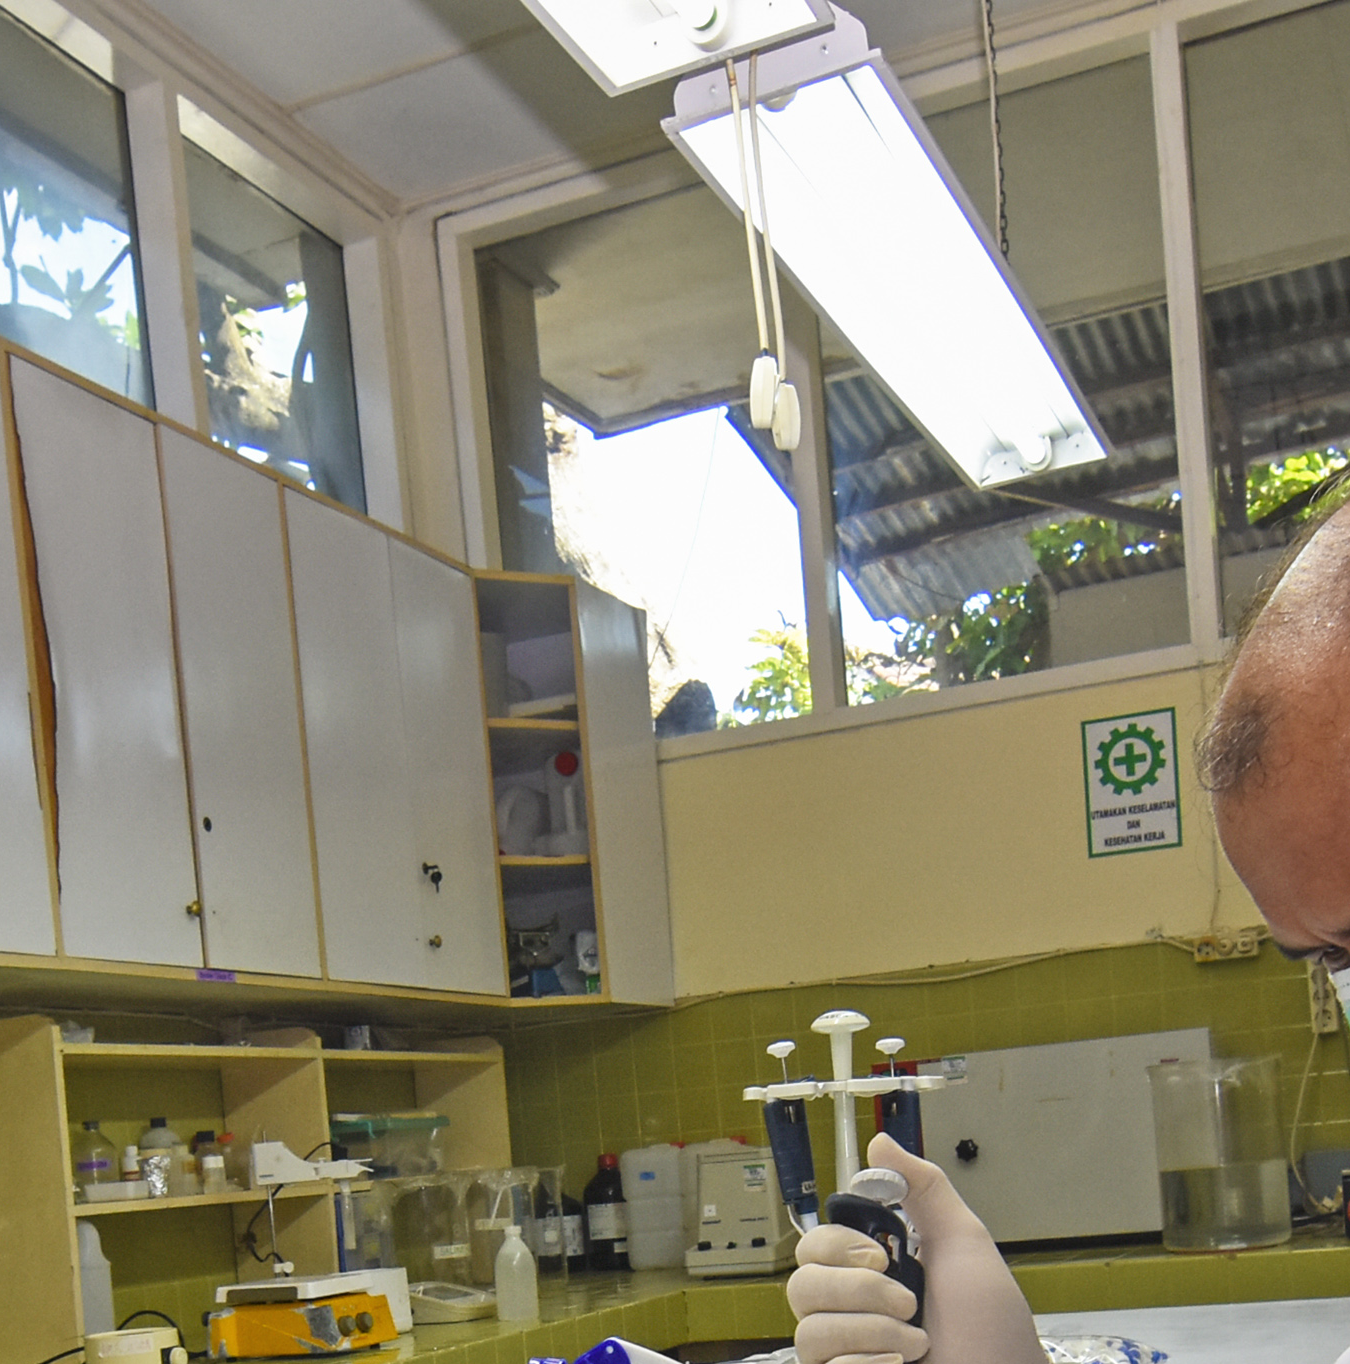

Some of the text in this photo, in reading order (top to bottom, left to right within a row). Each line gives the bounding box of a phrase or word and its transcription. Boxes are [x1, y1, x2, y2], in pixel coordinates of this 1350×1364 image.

[1091, 800, 1176, 821] UTAMAKAN KESELAMATAN
[1126, 819, 1141, 831] DAN
[1104, 830, 1166, 848] KESEHATAN KERJA
